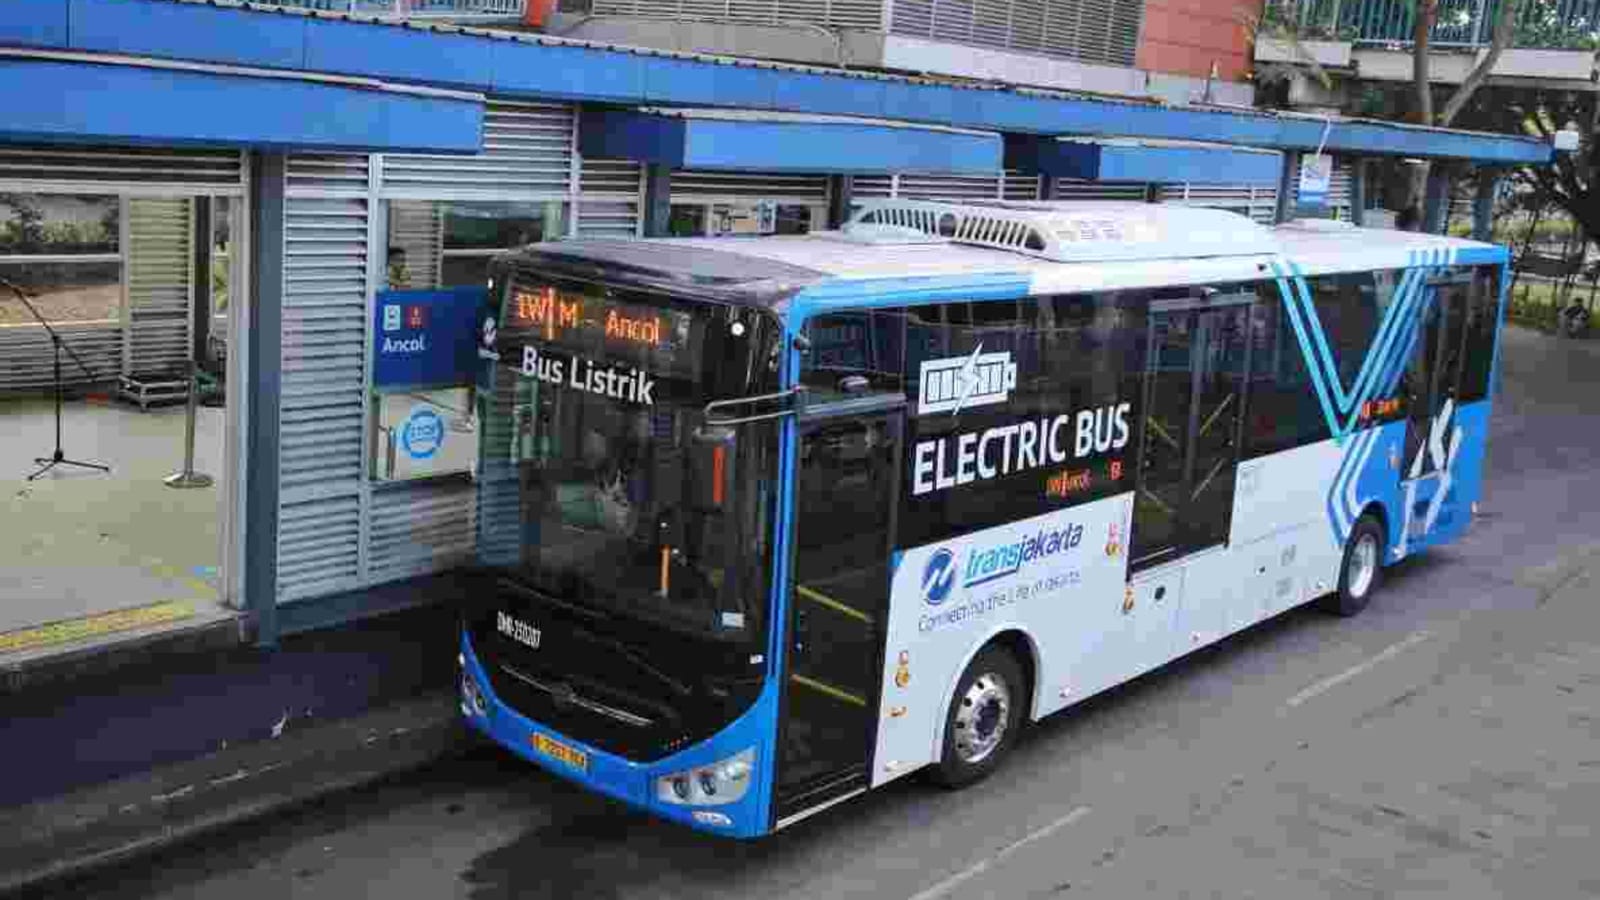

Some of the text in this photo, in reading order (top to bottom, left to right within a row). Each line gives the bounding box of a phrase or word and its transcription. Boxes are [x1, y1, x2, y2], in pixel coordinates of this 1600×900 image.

[382, 335, 426, 353] Ancol
[521, 345, 655, 405] Bus Listrik
[912, 402, 1131, 496] ELECTRIC BUS
[963, 521, 1084, 581] transjakarta
